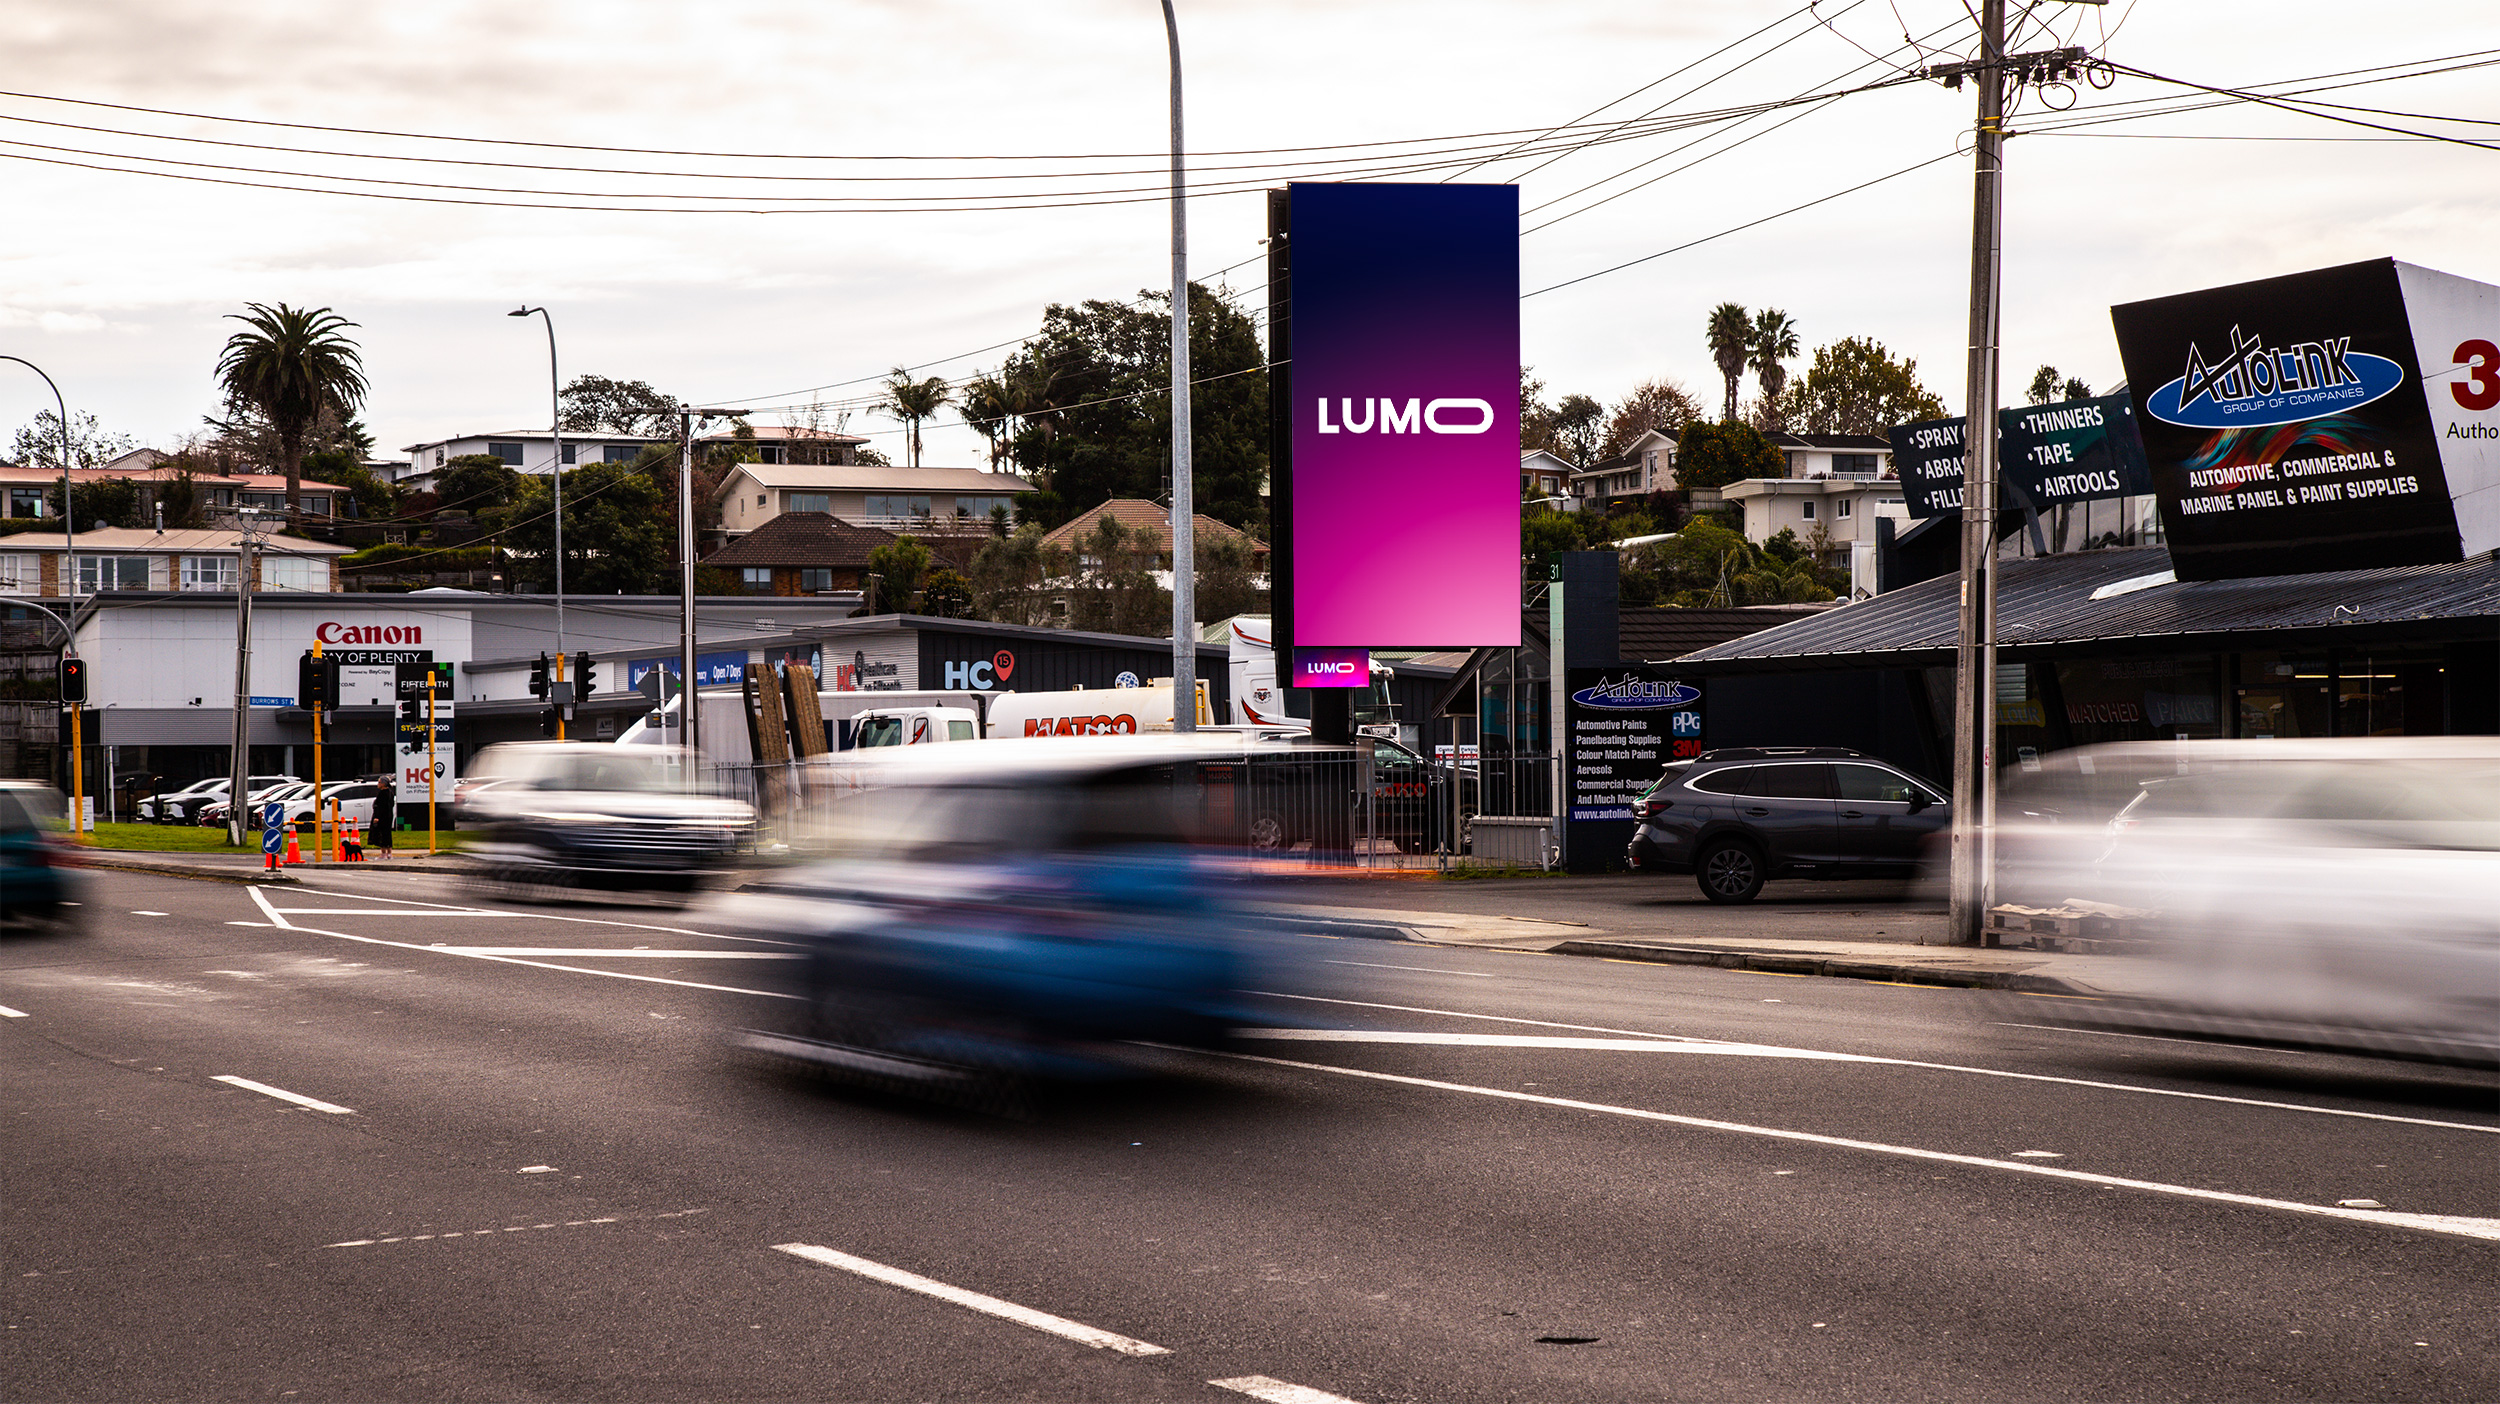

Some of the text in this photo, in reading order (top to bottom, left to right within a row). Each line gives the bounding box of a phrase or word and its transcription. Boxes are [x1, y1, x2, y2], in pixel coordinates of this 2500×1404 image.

[2223, 387, 2365, 415] GROUP OF COMPANIES
[1317, 397, 1495, 435] LUMO
[2026, 405, 2105, 435] THINNERS
[1915, 425, 1960, 450] SPRAY
[2446, 421, 2500, 440] Autho
[2033, 442, 2075, 466] TAPE
[2189, 449, 2396, 489] AUTOMOTIVE, COMMERCIAL &
[2045, 469, 2120, 498] AIRTOOLS
[2180, 475, 2419, 516] MARINE PANEL & PAINT SUPPLIES
[1550, 564, 1559, 580] 31
[316, 621, 422, 645] Canon
[348, 652, 367, 663] OF
[370, 652, 421, 663] PLENTY
[712, 665, 726, 682] Open
[730, 664, 742, 681] Days
[836, 663, 856, 692] HC
[945, 655, 1011, 690] HC 15
[1307, 662, 1355, 674] LUMO
[251, 697, 279, 705] BURROWS
[1672, 711, 1700, 733] PPG
[2066, 702, 2140, 724] MATCHED
[1024, 713, 1137, 738] MATCO
[1576, 720, 1648, 730] Automotive Paints
[1576, 734, 1662, 746] Panelbeating Supplies
[1672, 739, 1702, 758] 3M
[1576, 749, 1657, 760] Colour Match Paints
[1576, 764, 1613, 775] Aerosols
[1577, 779, 1654, 791] Commercial Supplie
[1577, 794, 1592, 805] And
[1594, 794, 1617, 805] Much
[1574, 808, 1634, 820] www.autolink
